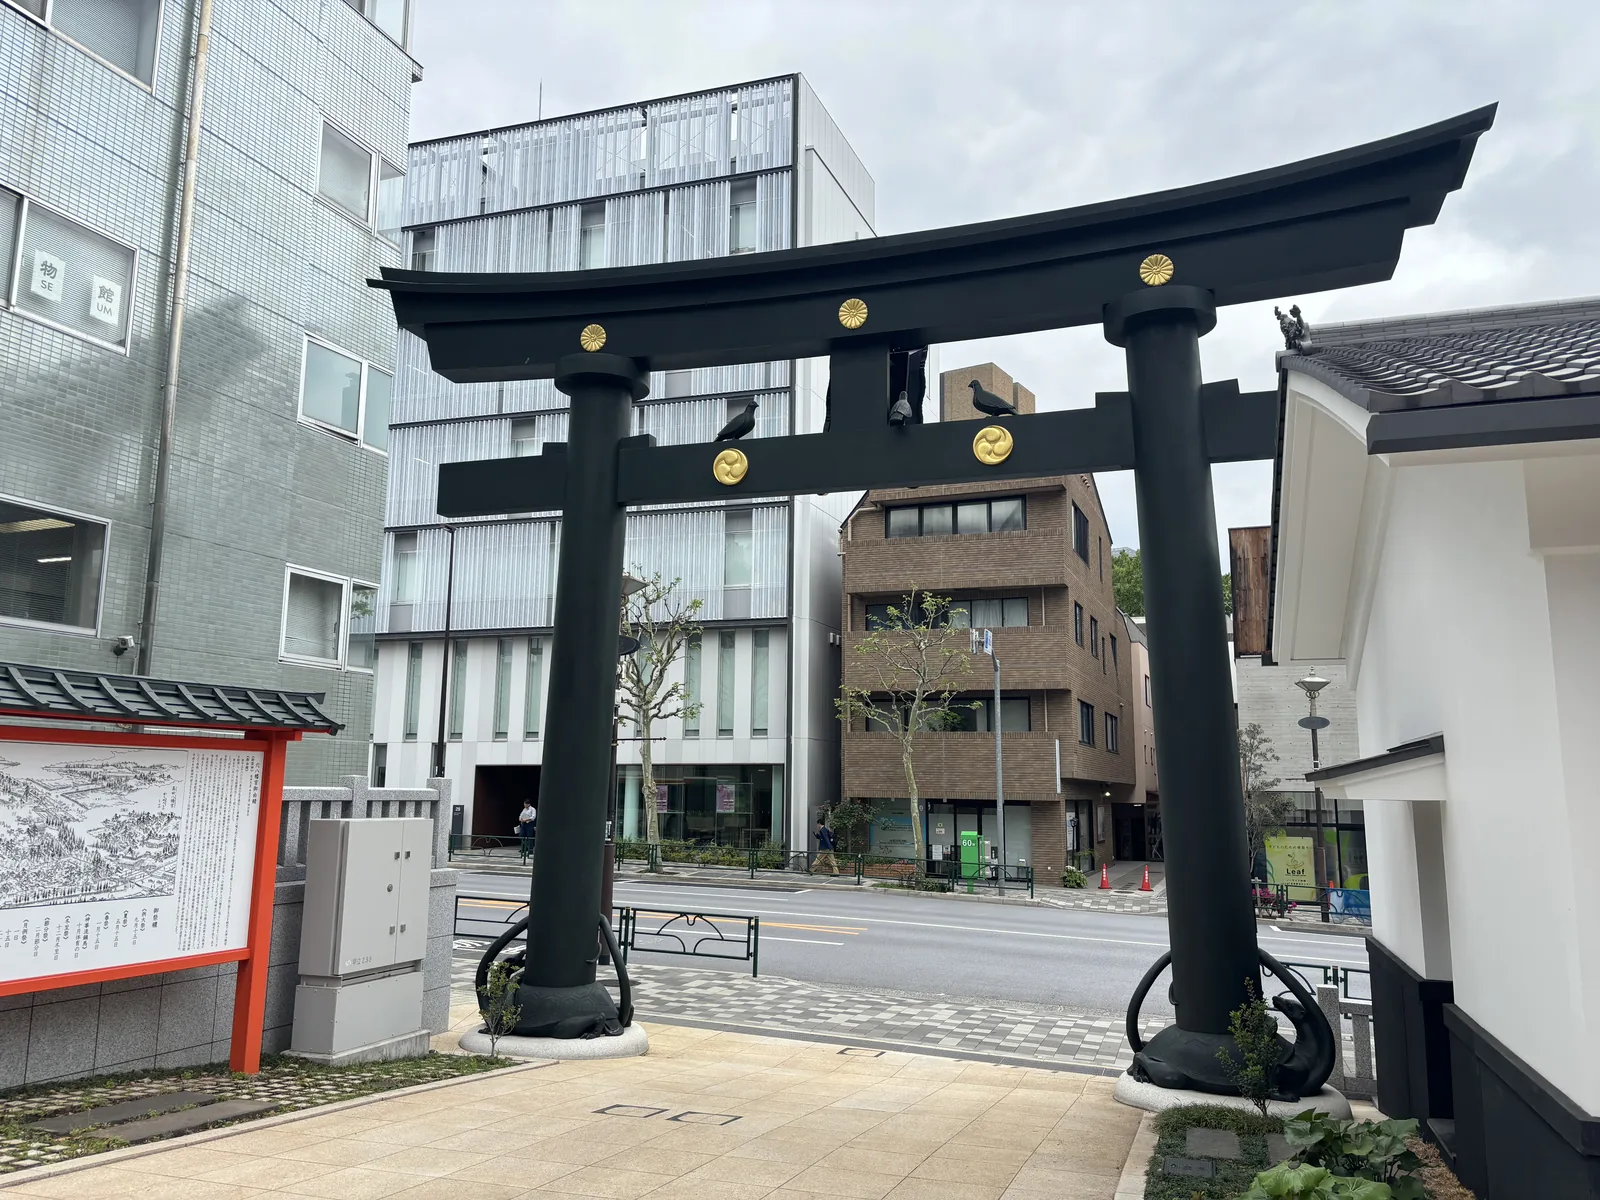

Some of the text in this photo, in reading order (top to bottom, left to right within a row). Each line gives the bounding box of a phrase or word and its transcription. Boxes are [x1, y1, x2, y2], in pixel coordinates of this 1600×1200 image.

[40, 259, 58, 280] 物
[40, 280, 53, 292] SE
[97, 285, 115, 303] 館
[96, 304, 113, 317] UM
